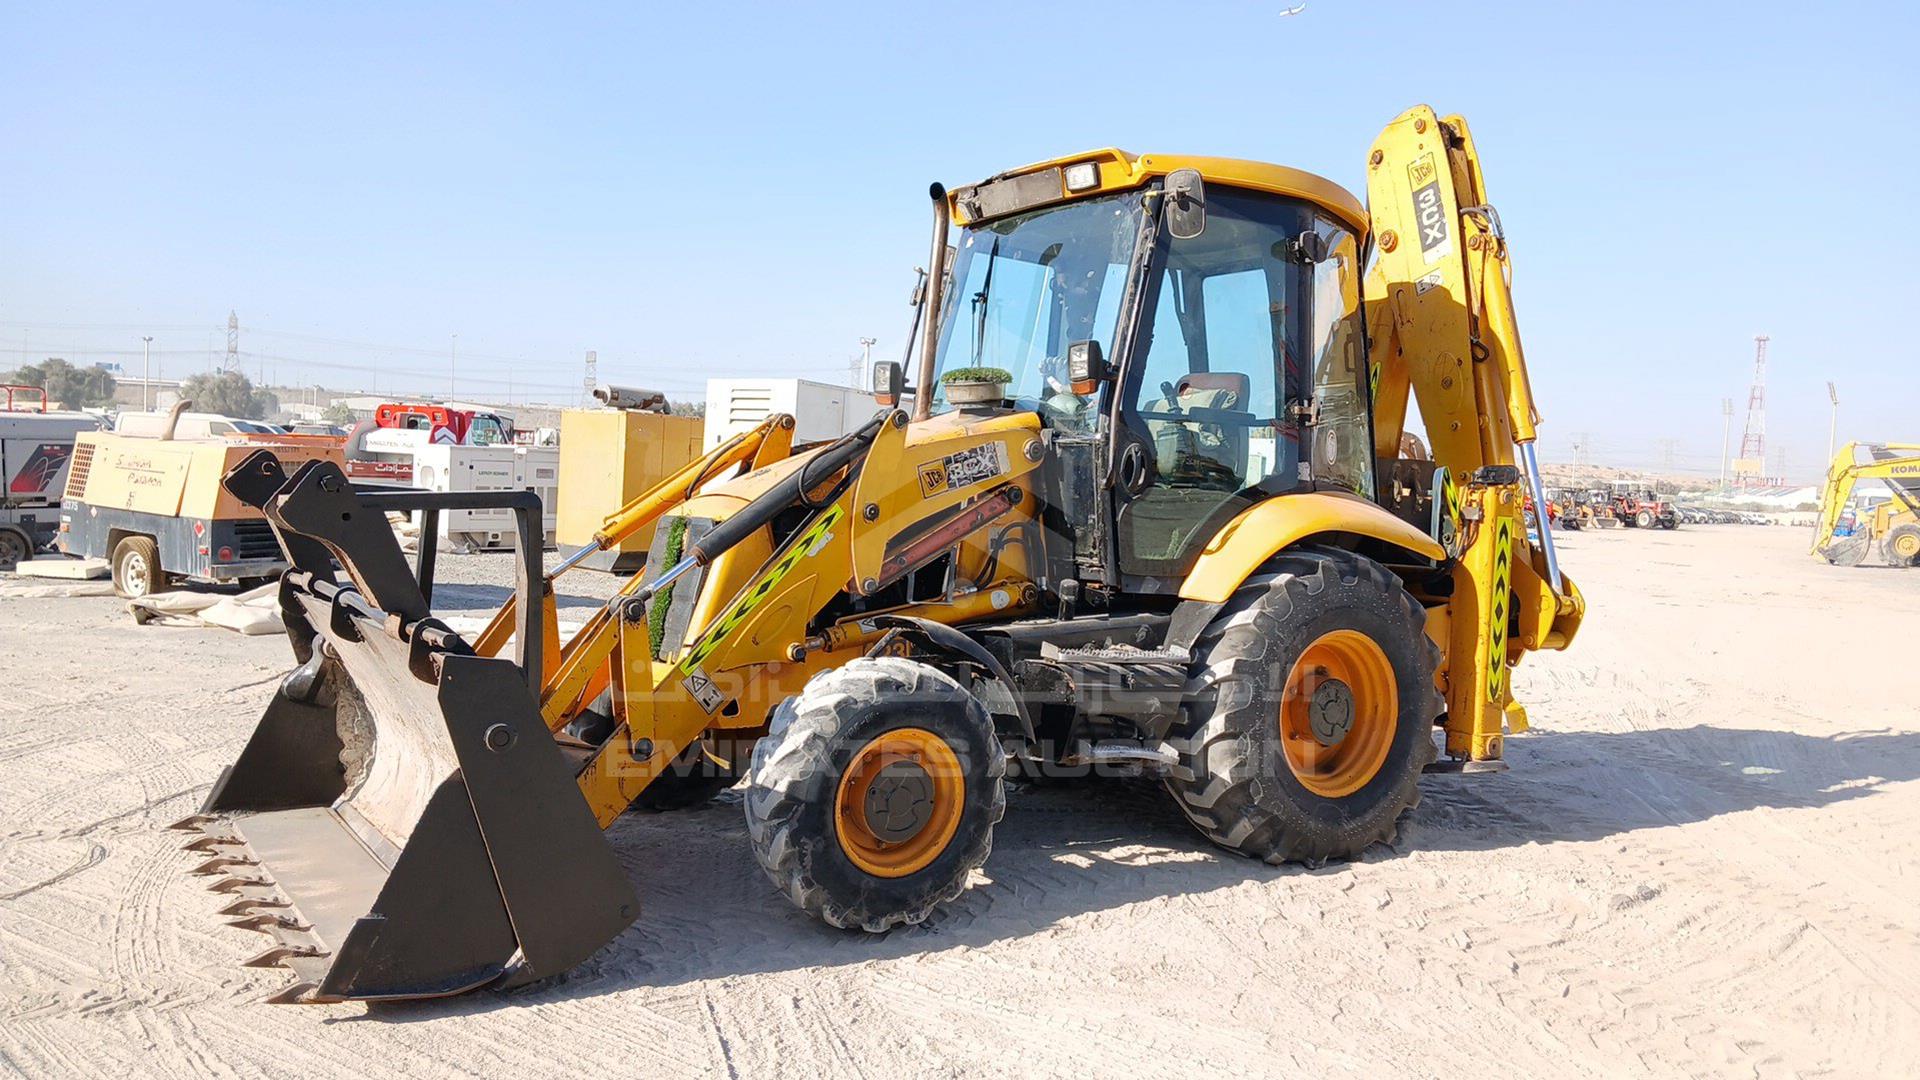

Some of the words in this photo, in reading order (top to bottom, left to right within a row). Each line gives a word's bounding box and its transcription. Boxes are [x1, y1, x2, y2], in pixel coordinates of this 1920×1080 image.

[1414, 163, 1433, 183] JCB
[1419, 188, 1444, 245] 3CX
[375, 463, 413, 474] مزادات
[1891, 465, 1920, 474] KOM
[925, 469, 944, 489] JCB
